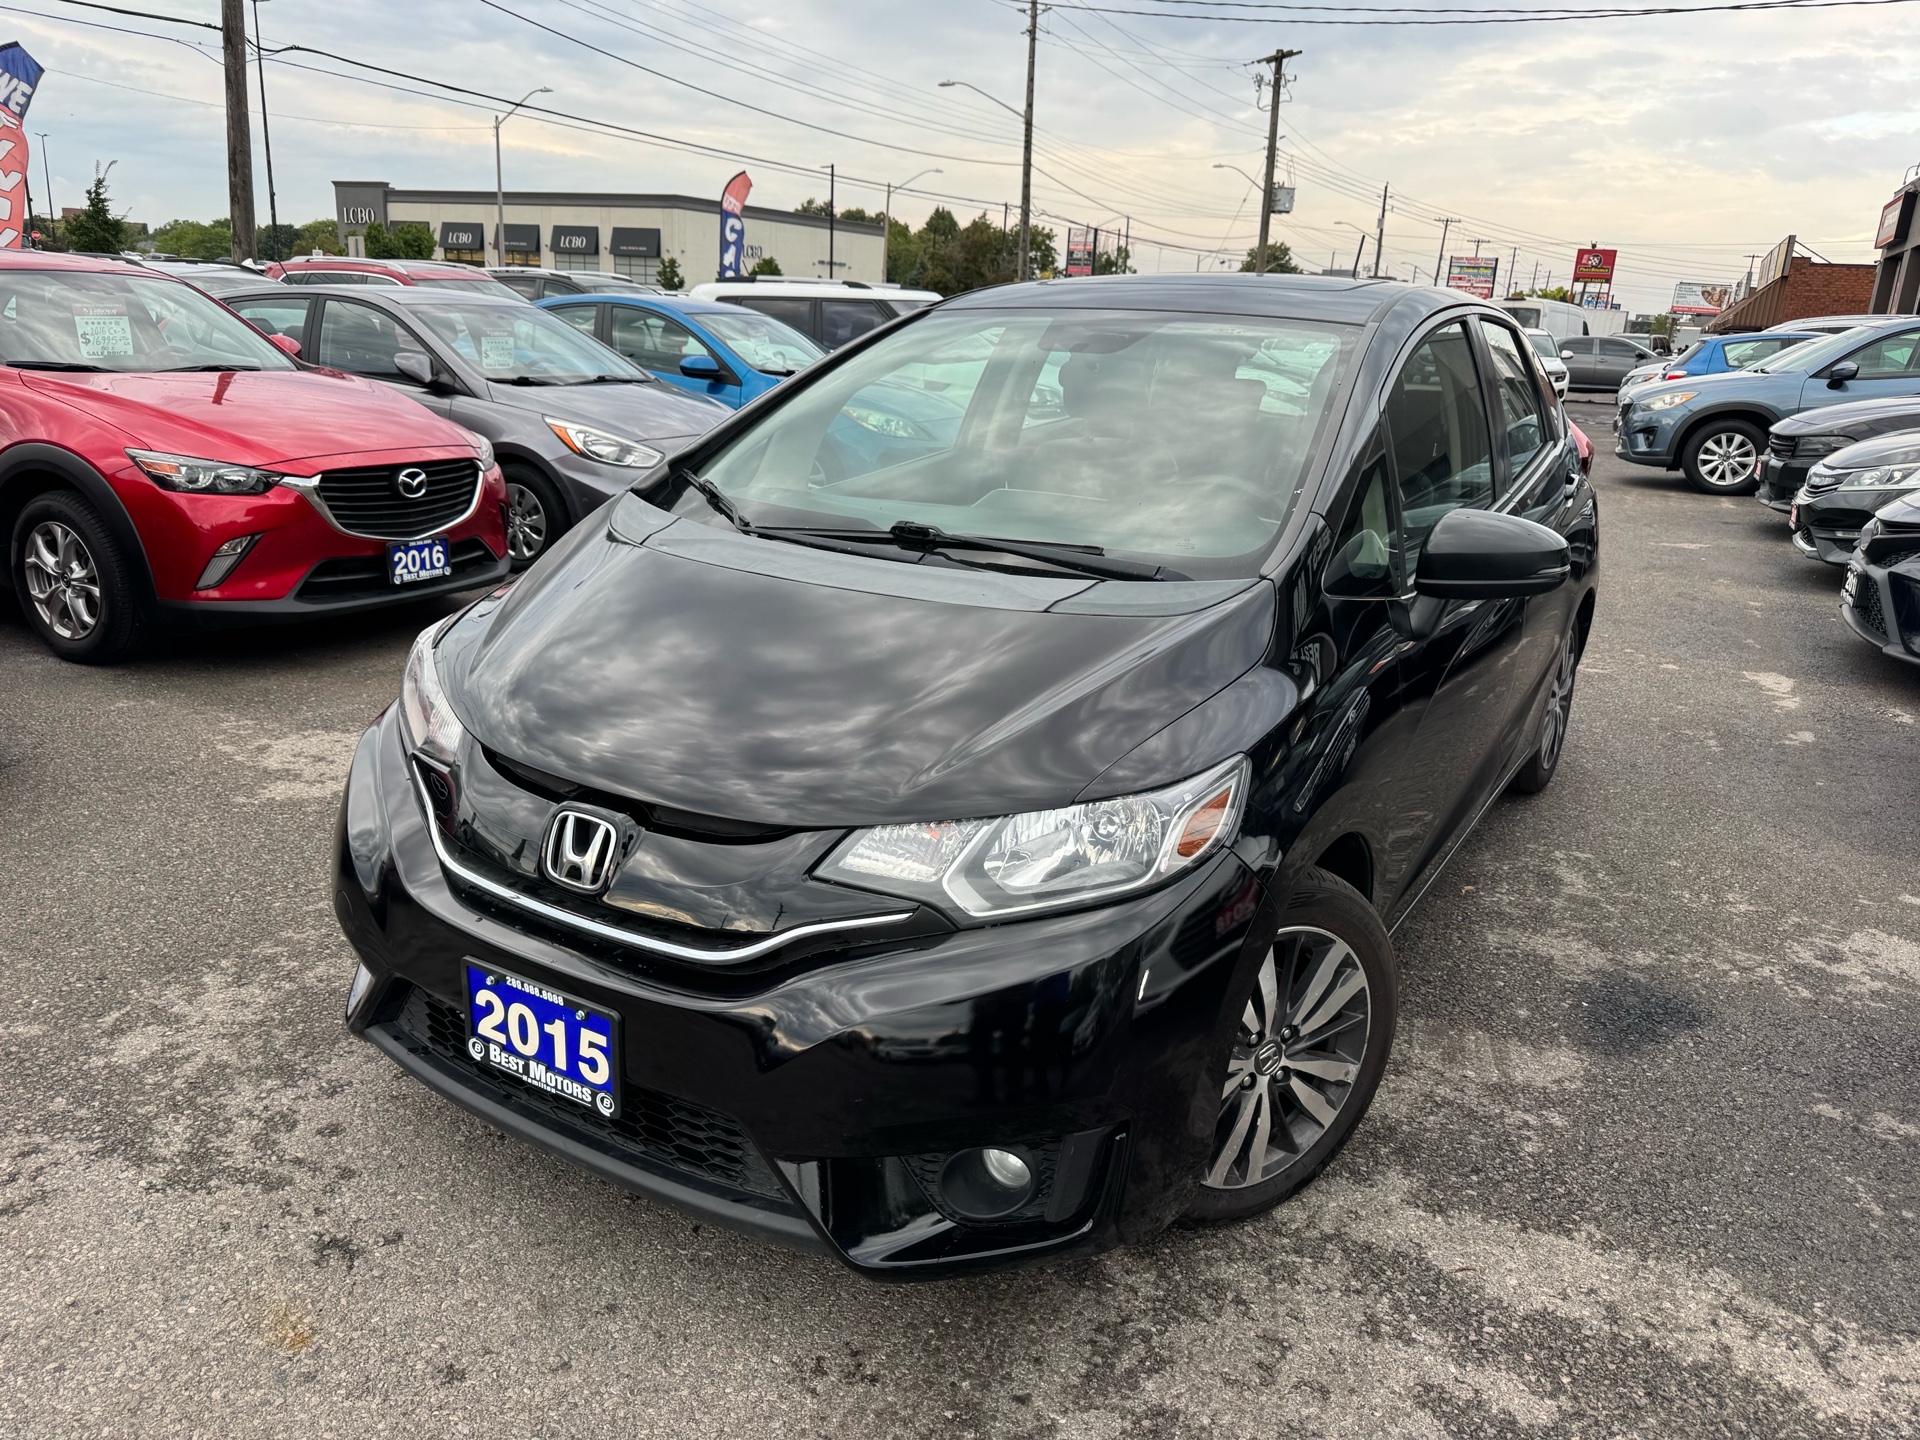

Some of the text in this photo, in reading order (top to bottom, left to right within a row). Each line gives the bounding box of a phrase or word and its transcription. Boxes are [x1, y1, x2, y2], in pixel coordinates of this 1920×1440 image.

[343, 207, 375, 224] LCBO
[448, 231, 472, 244] LCBO
[560, 235, 586, 248] LCBO
[393, 545, 445, 575] 2016
[475, 989, 610, 1085] 2015
[489, 1043, 592, 1103] BEST MOTORS
[522, 1075, 556, 1094] Hamilton
